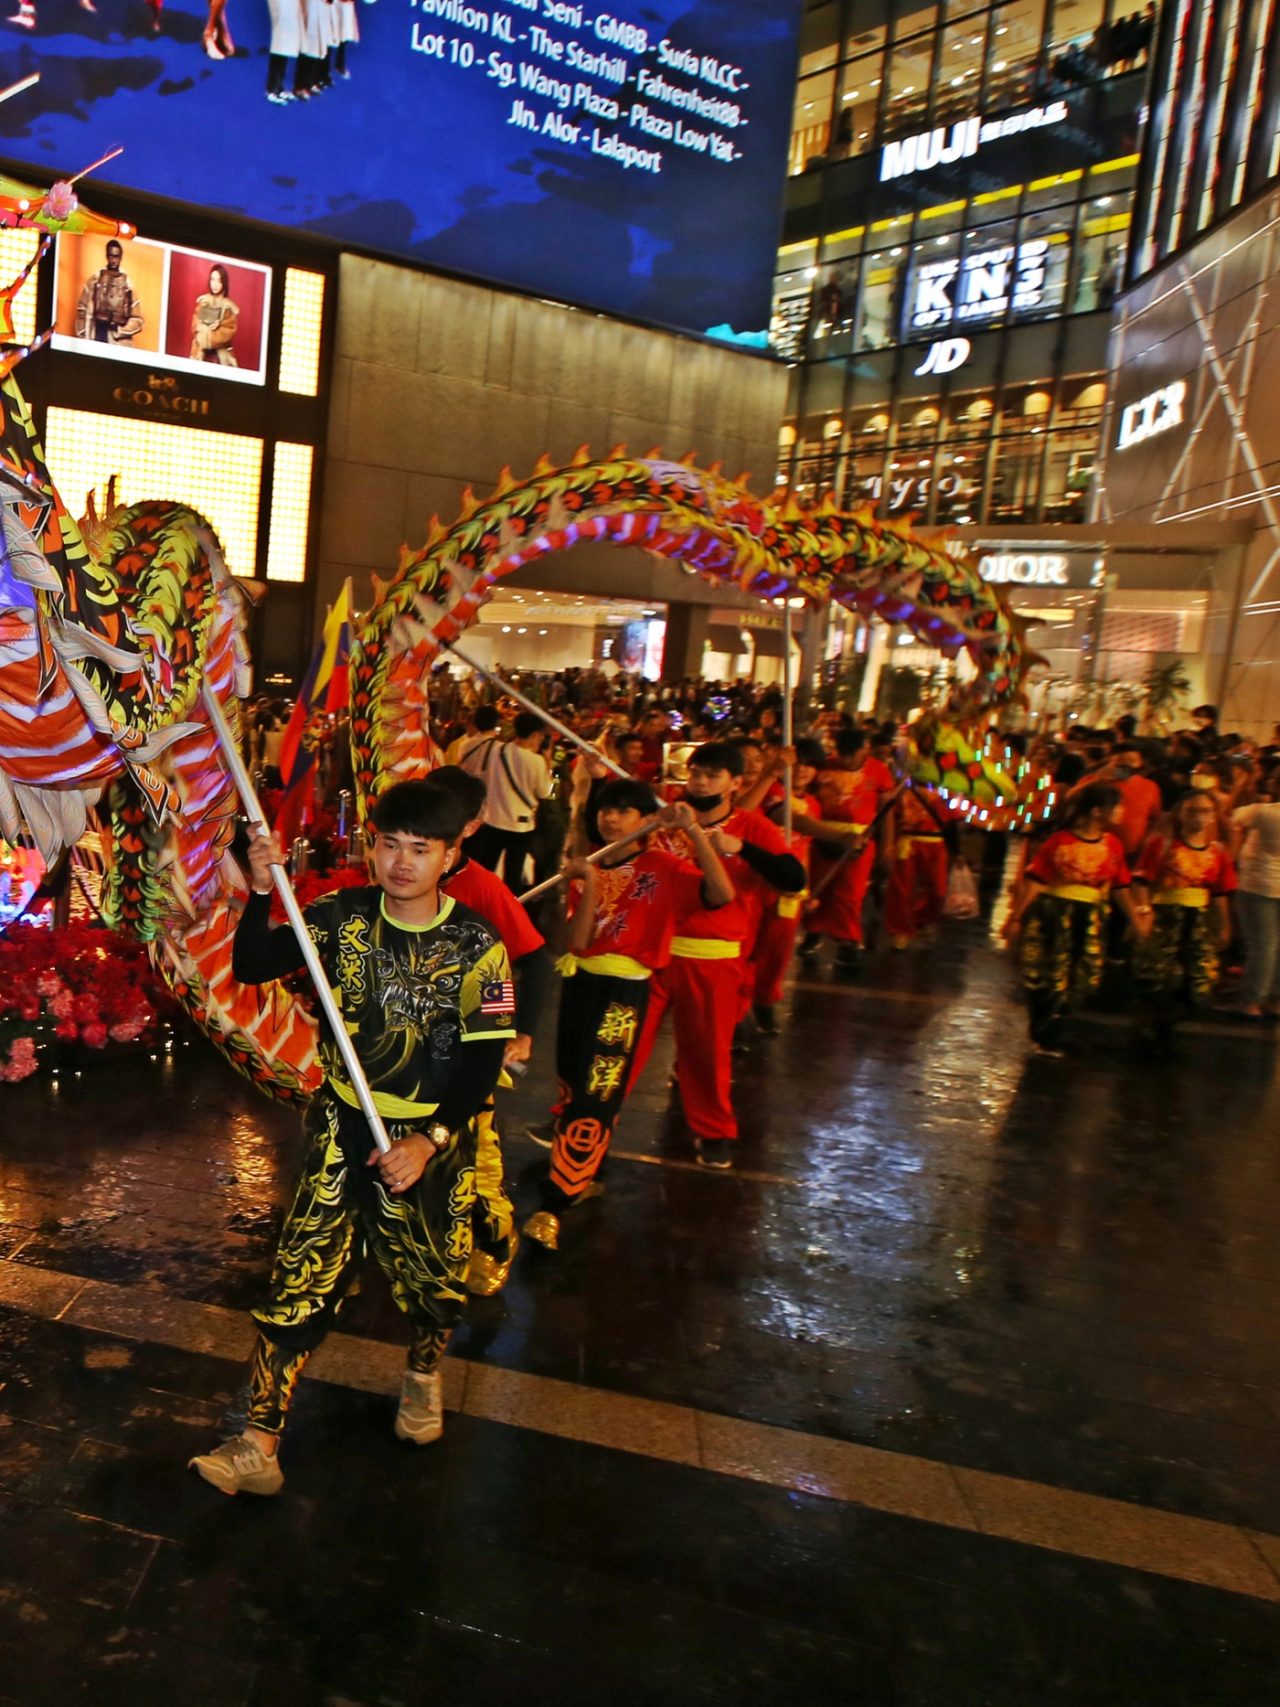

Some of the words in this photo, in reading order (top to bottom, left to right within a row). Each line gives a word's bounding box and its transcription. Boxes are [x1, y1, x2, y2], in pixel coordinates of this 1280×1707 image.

[410, 0, 488, 33] avilion
[491, 12, 516, 43] KL
[529, 26, 564, 61] The
[565, 41, 627, 84] Starhill
[637, 69, 740, 127] Fahrenheit88
[542, 0, 583, 29] Seni
[594, 14, 648, 53] GMBB
[657, 39, 699, 75] Suria
[700, 55, 742, 92] KLCC
[411, 23, 446, 59] Lot
[450, 38, 474, 68] 10
[486, 52, 517, 88] Sg.
[519, 62, 571, 108] Wang
[573, 82, 619, 120] Plaza
[630, 104, 673, 140] Plaza
[673, 120, 709, 152] Low
[709, 132, 734, 162] Yat
[506, 100, 540, 132] Jln.
[541, 112, 581, 144] Alor
[591, 128, 662, 174] Lalaport
[879, 116, 982, 182] MUJI
[914, 338, 971, 376] JD
